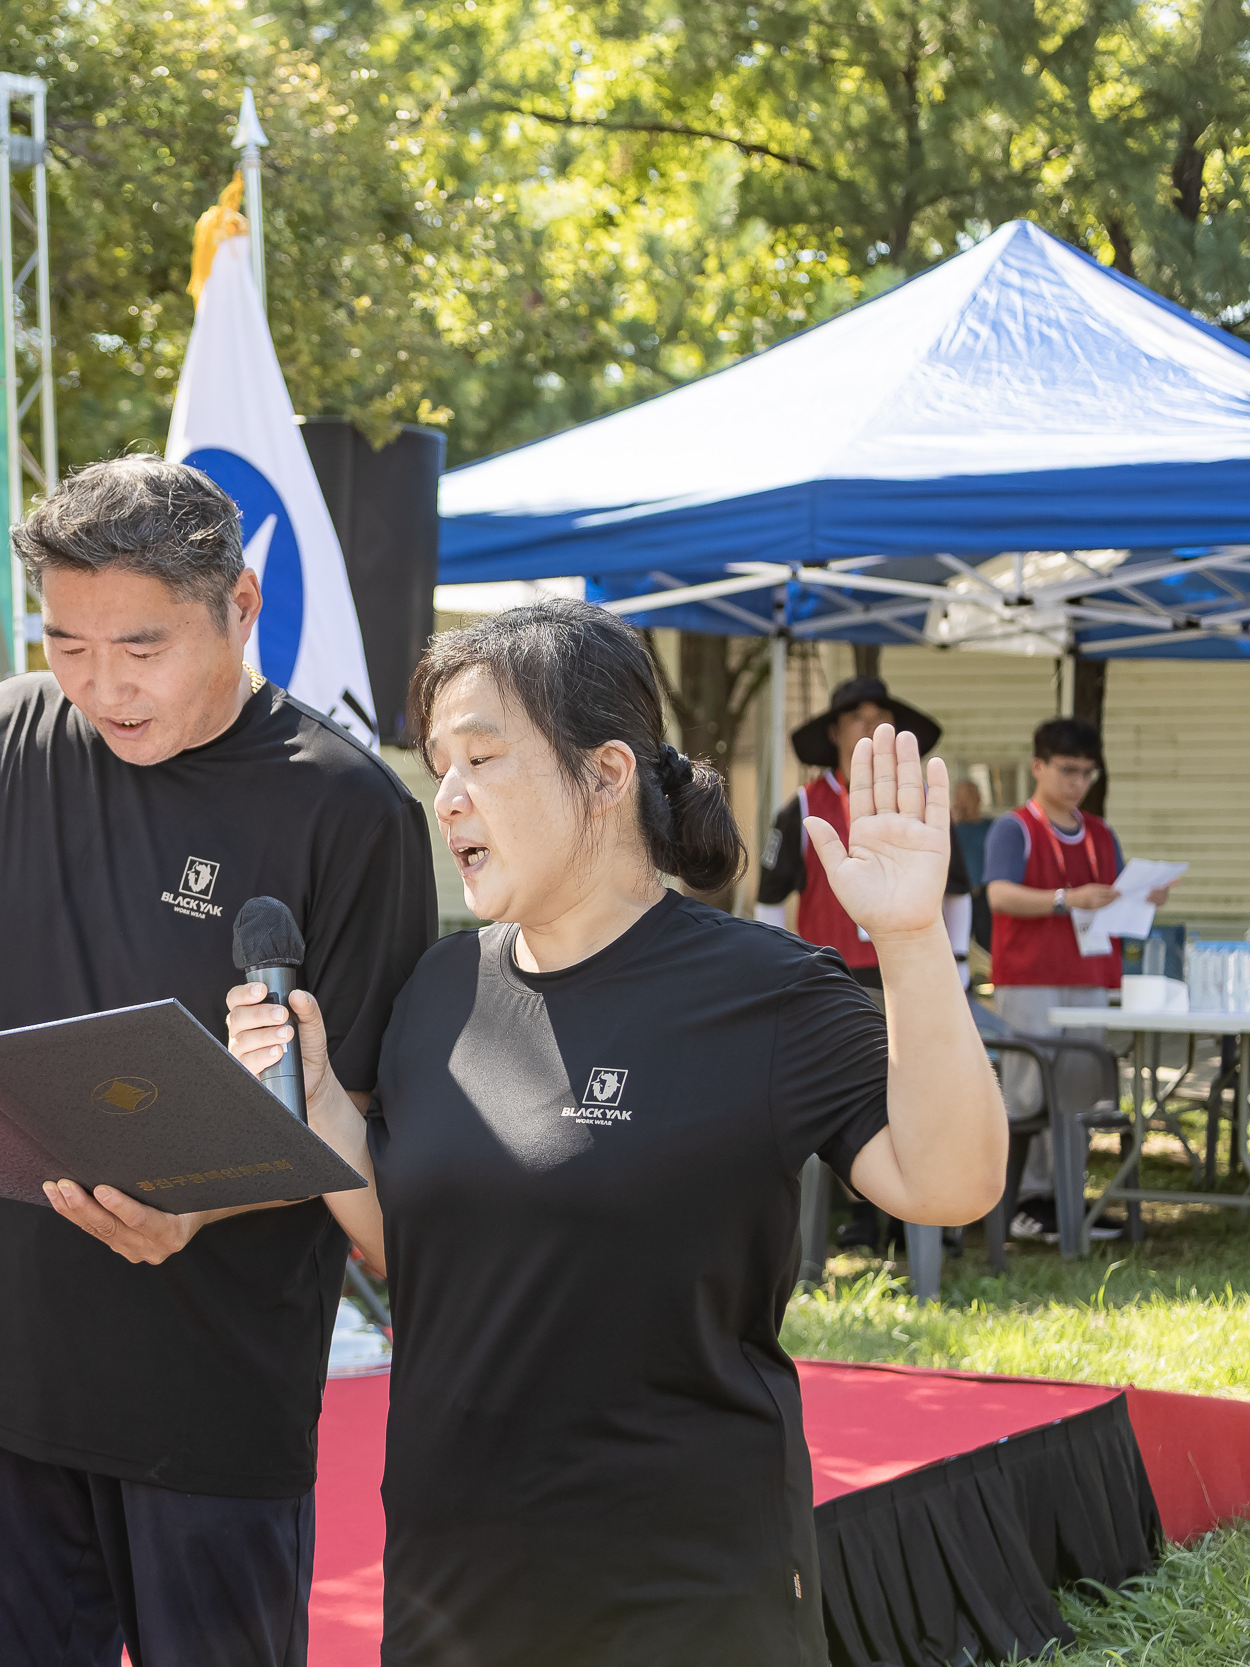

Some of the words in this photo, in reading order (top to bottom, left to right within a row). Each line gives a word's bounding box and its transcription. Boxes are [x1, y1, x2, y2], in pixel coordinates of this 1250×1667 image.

[173, 905, 191, 915] WORK
[190, 910, 206, 919] WEAR
[594, 1119, 613, 1127] WEAR
